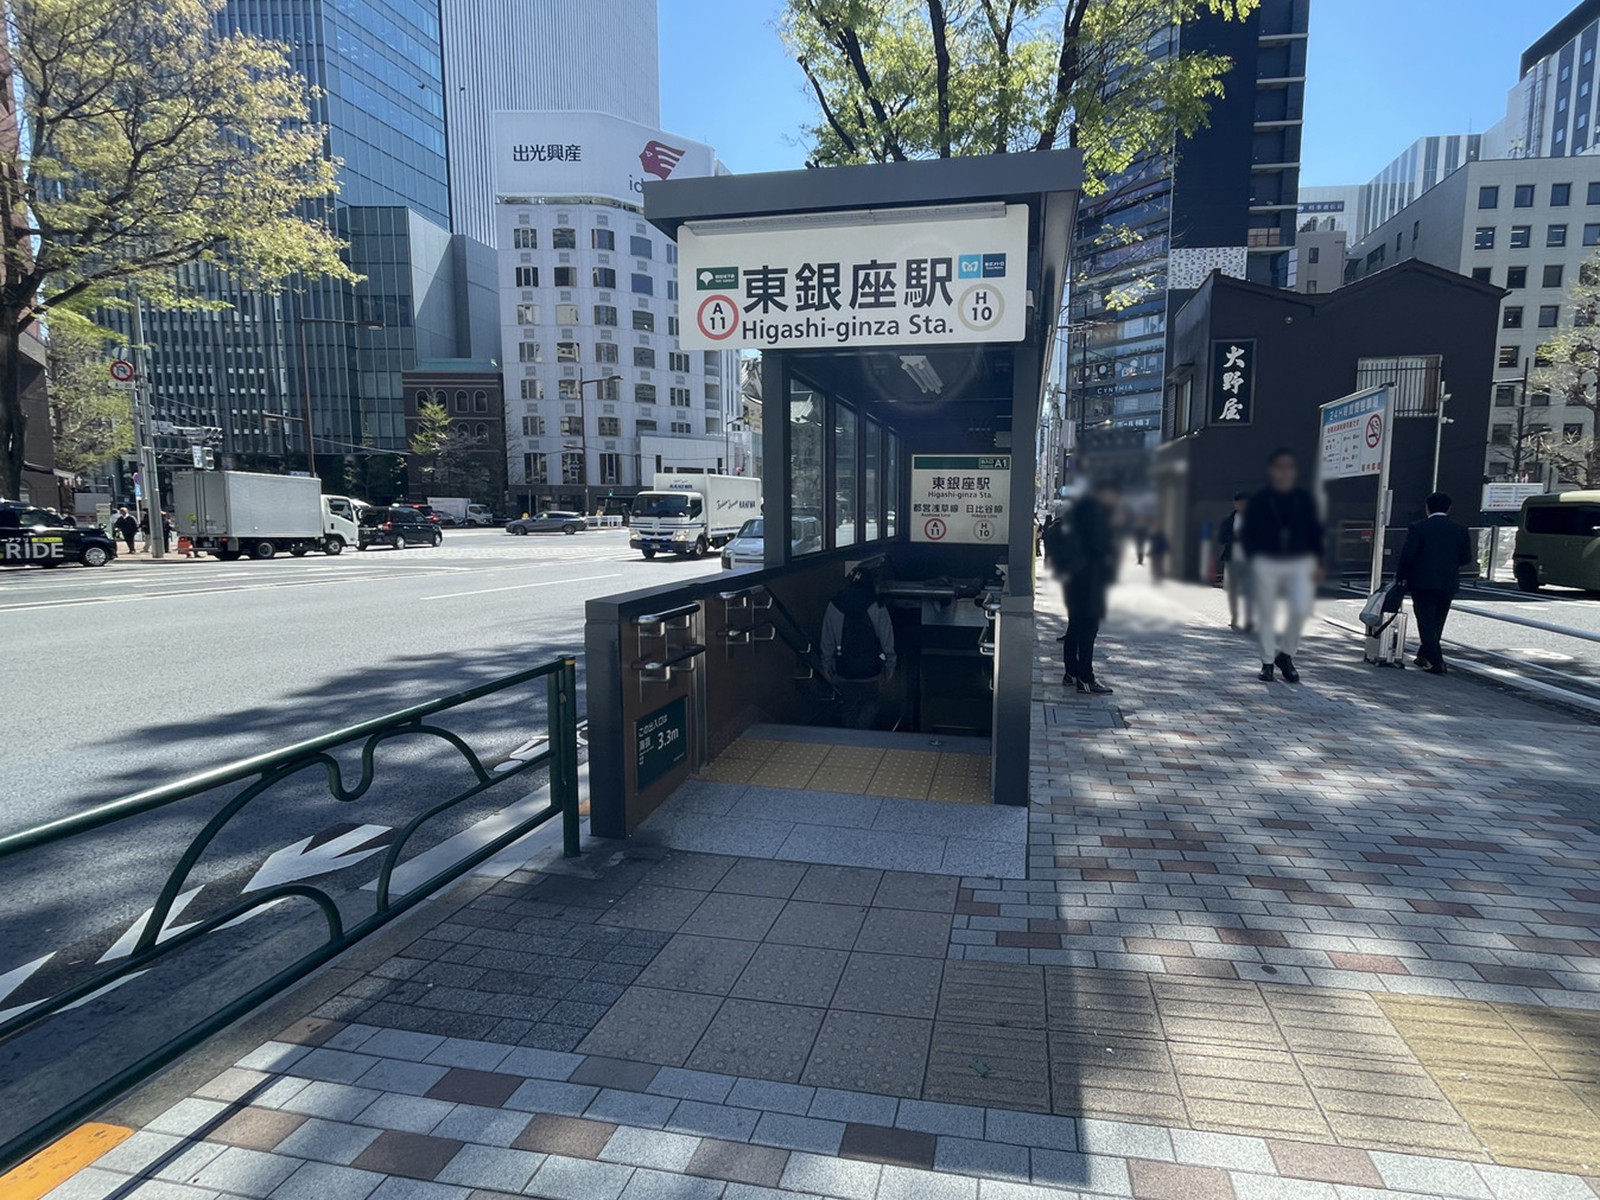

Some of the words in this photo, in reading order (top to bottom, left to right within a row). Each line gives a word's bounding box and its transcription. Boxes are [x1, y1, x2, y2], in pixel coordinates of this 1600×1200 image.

[513, 144, 581, 162] 出光興産
[743, 256, 953, 315] 東銀座駅
[975, 292, 987, 305] H
[711, 303, 724, 316] A
[971, 306, 993, 321] 10
[709, 316, 726, 331] 11
[742, 316, 900, 344] Higashi-ginza
[908, 314, 954, 335] Sta.
[1097, 384, 1133, 394] CYNTHIA
[1219, 345, 1246, 420] 大野屋
[932, 476, 990, 490] 東銀座駅
[928, 491, 977, 499] Higashi-ginza
[914, 504, 958, 512] 都営浅草線
[966, 505, 1003, 513] 日比谷線
[658, 728, 678, 749] 3.3m
